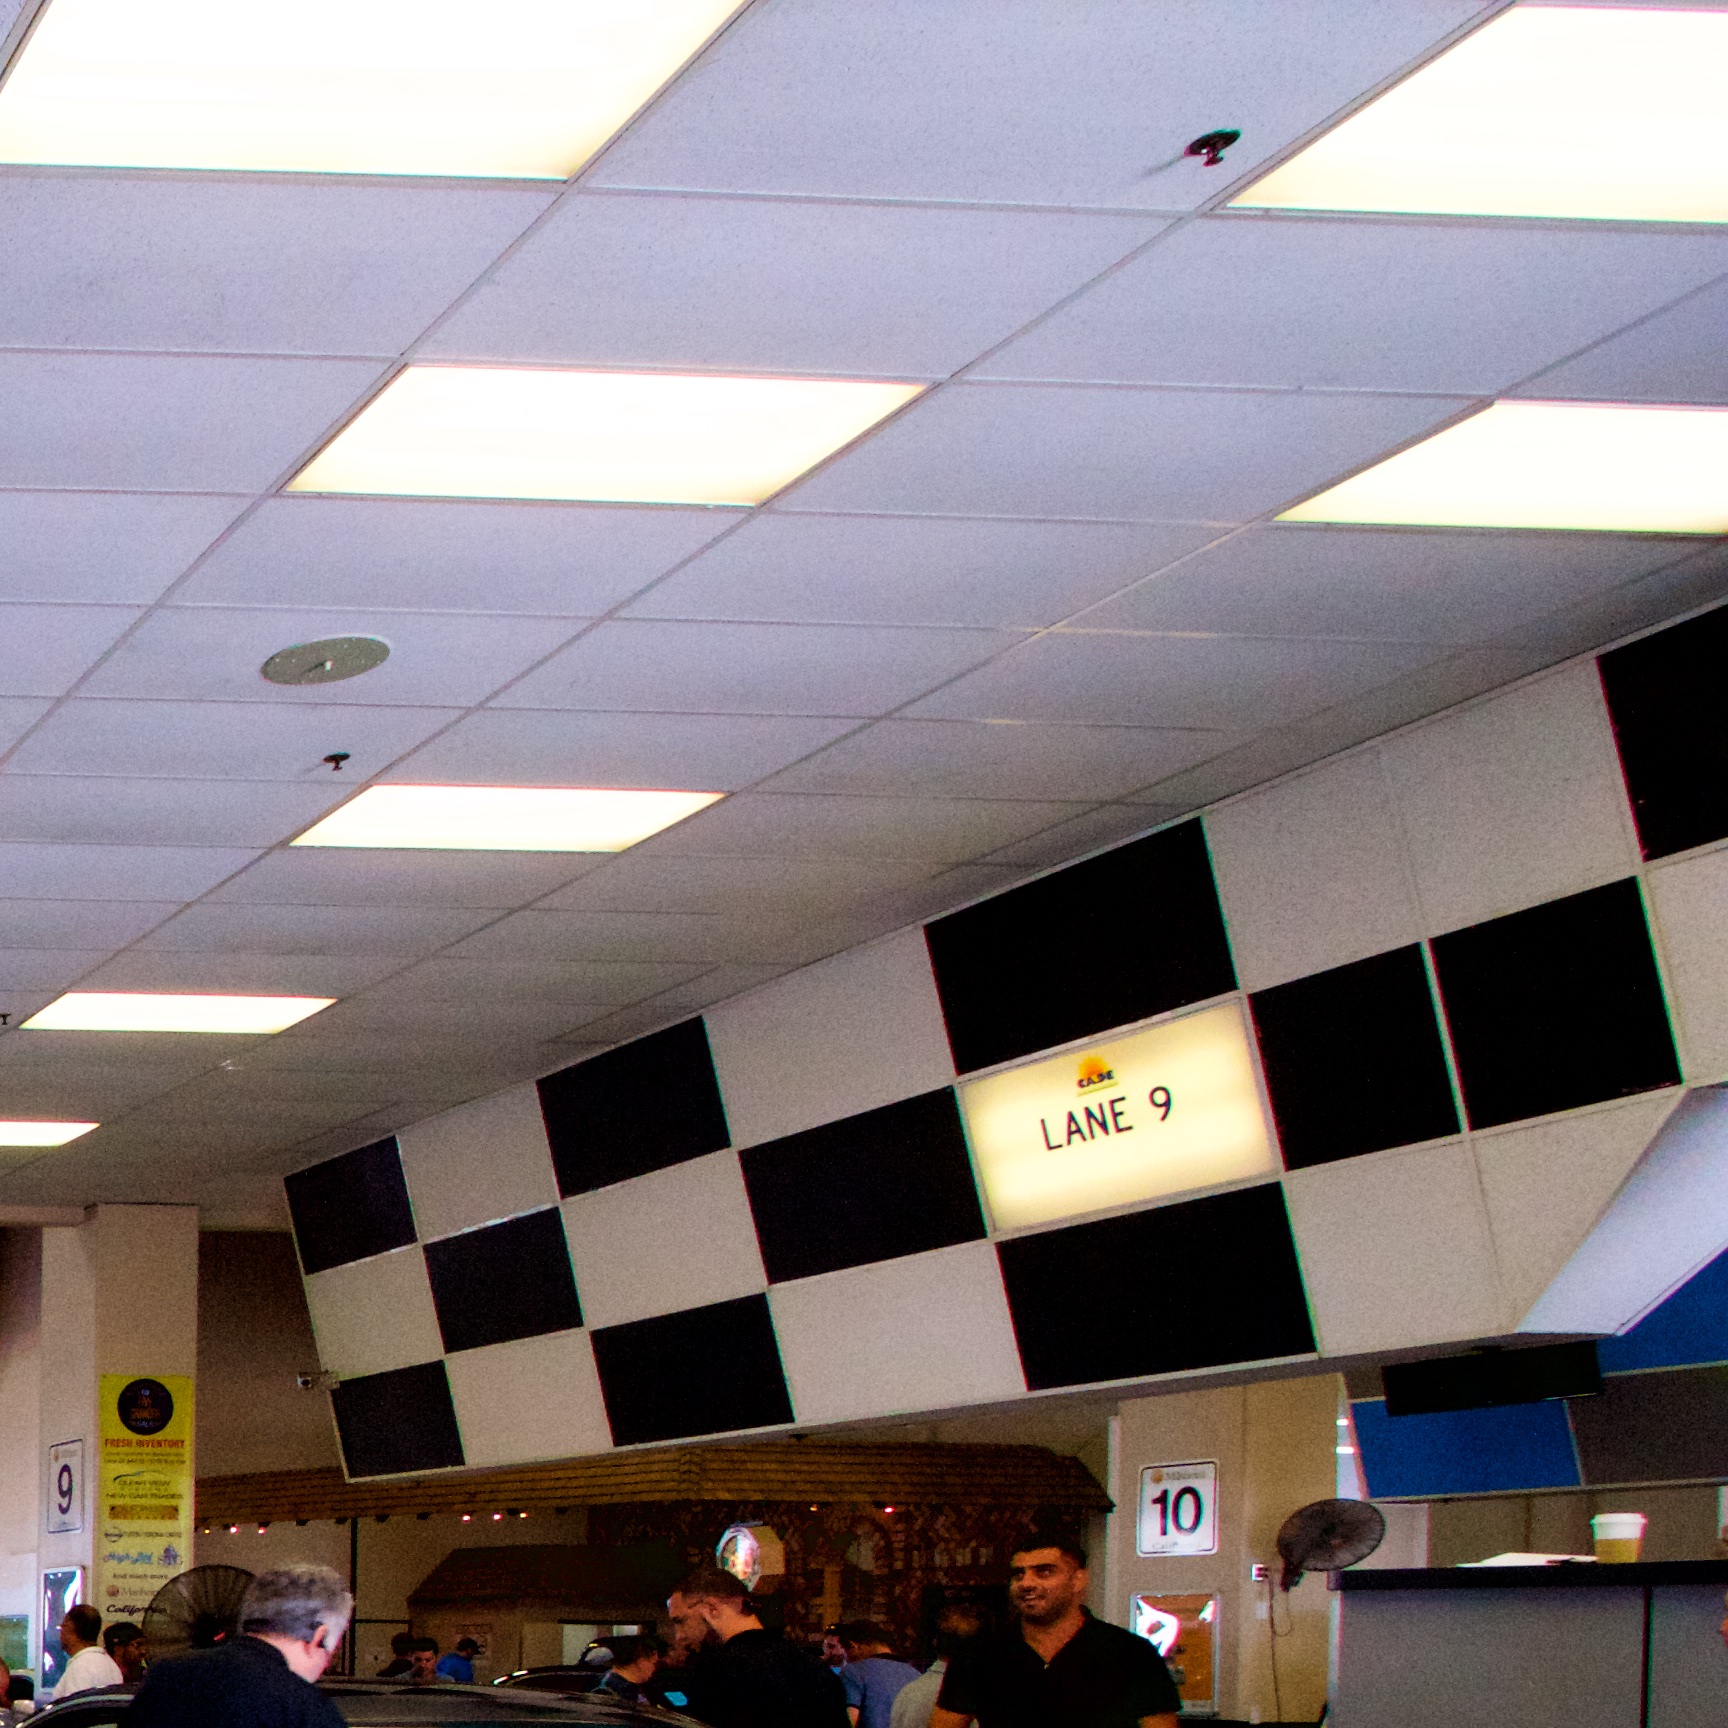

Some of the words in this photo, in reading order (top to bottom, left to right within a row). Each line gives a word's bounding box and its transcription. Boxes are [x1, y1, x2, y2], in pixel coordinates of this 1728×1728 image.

[1040, 1096, 1134, 1151] LANE
[1149, 1086, 1173, 1122] 9
[135, 1438, 186, 1449] INVENTORY
[57, 1463, 73, 1515] 9
[1151, 1486, 1205, 1537] 10
